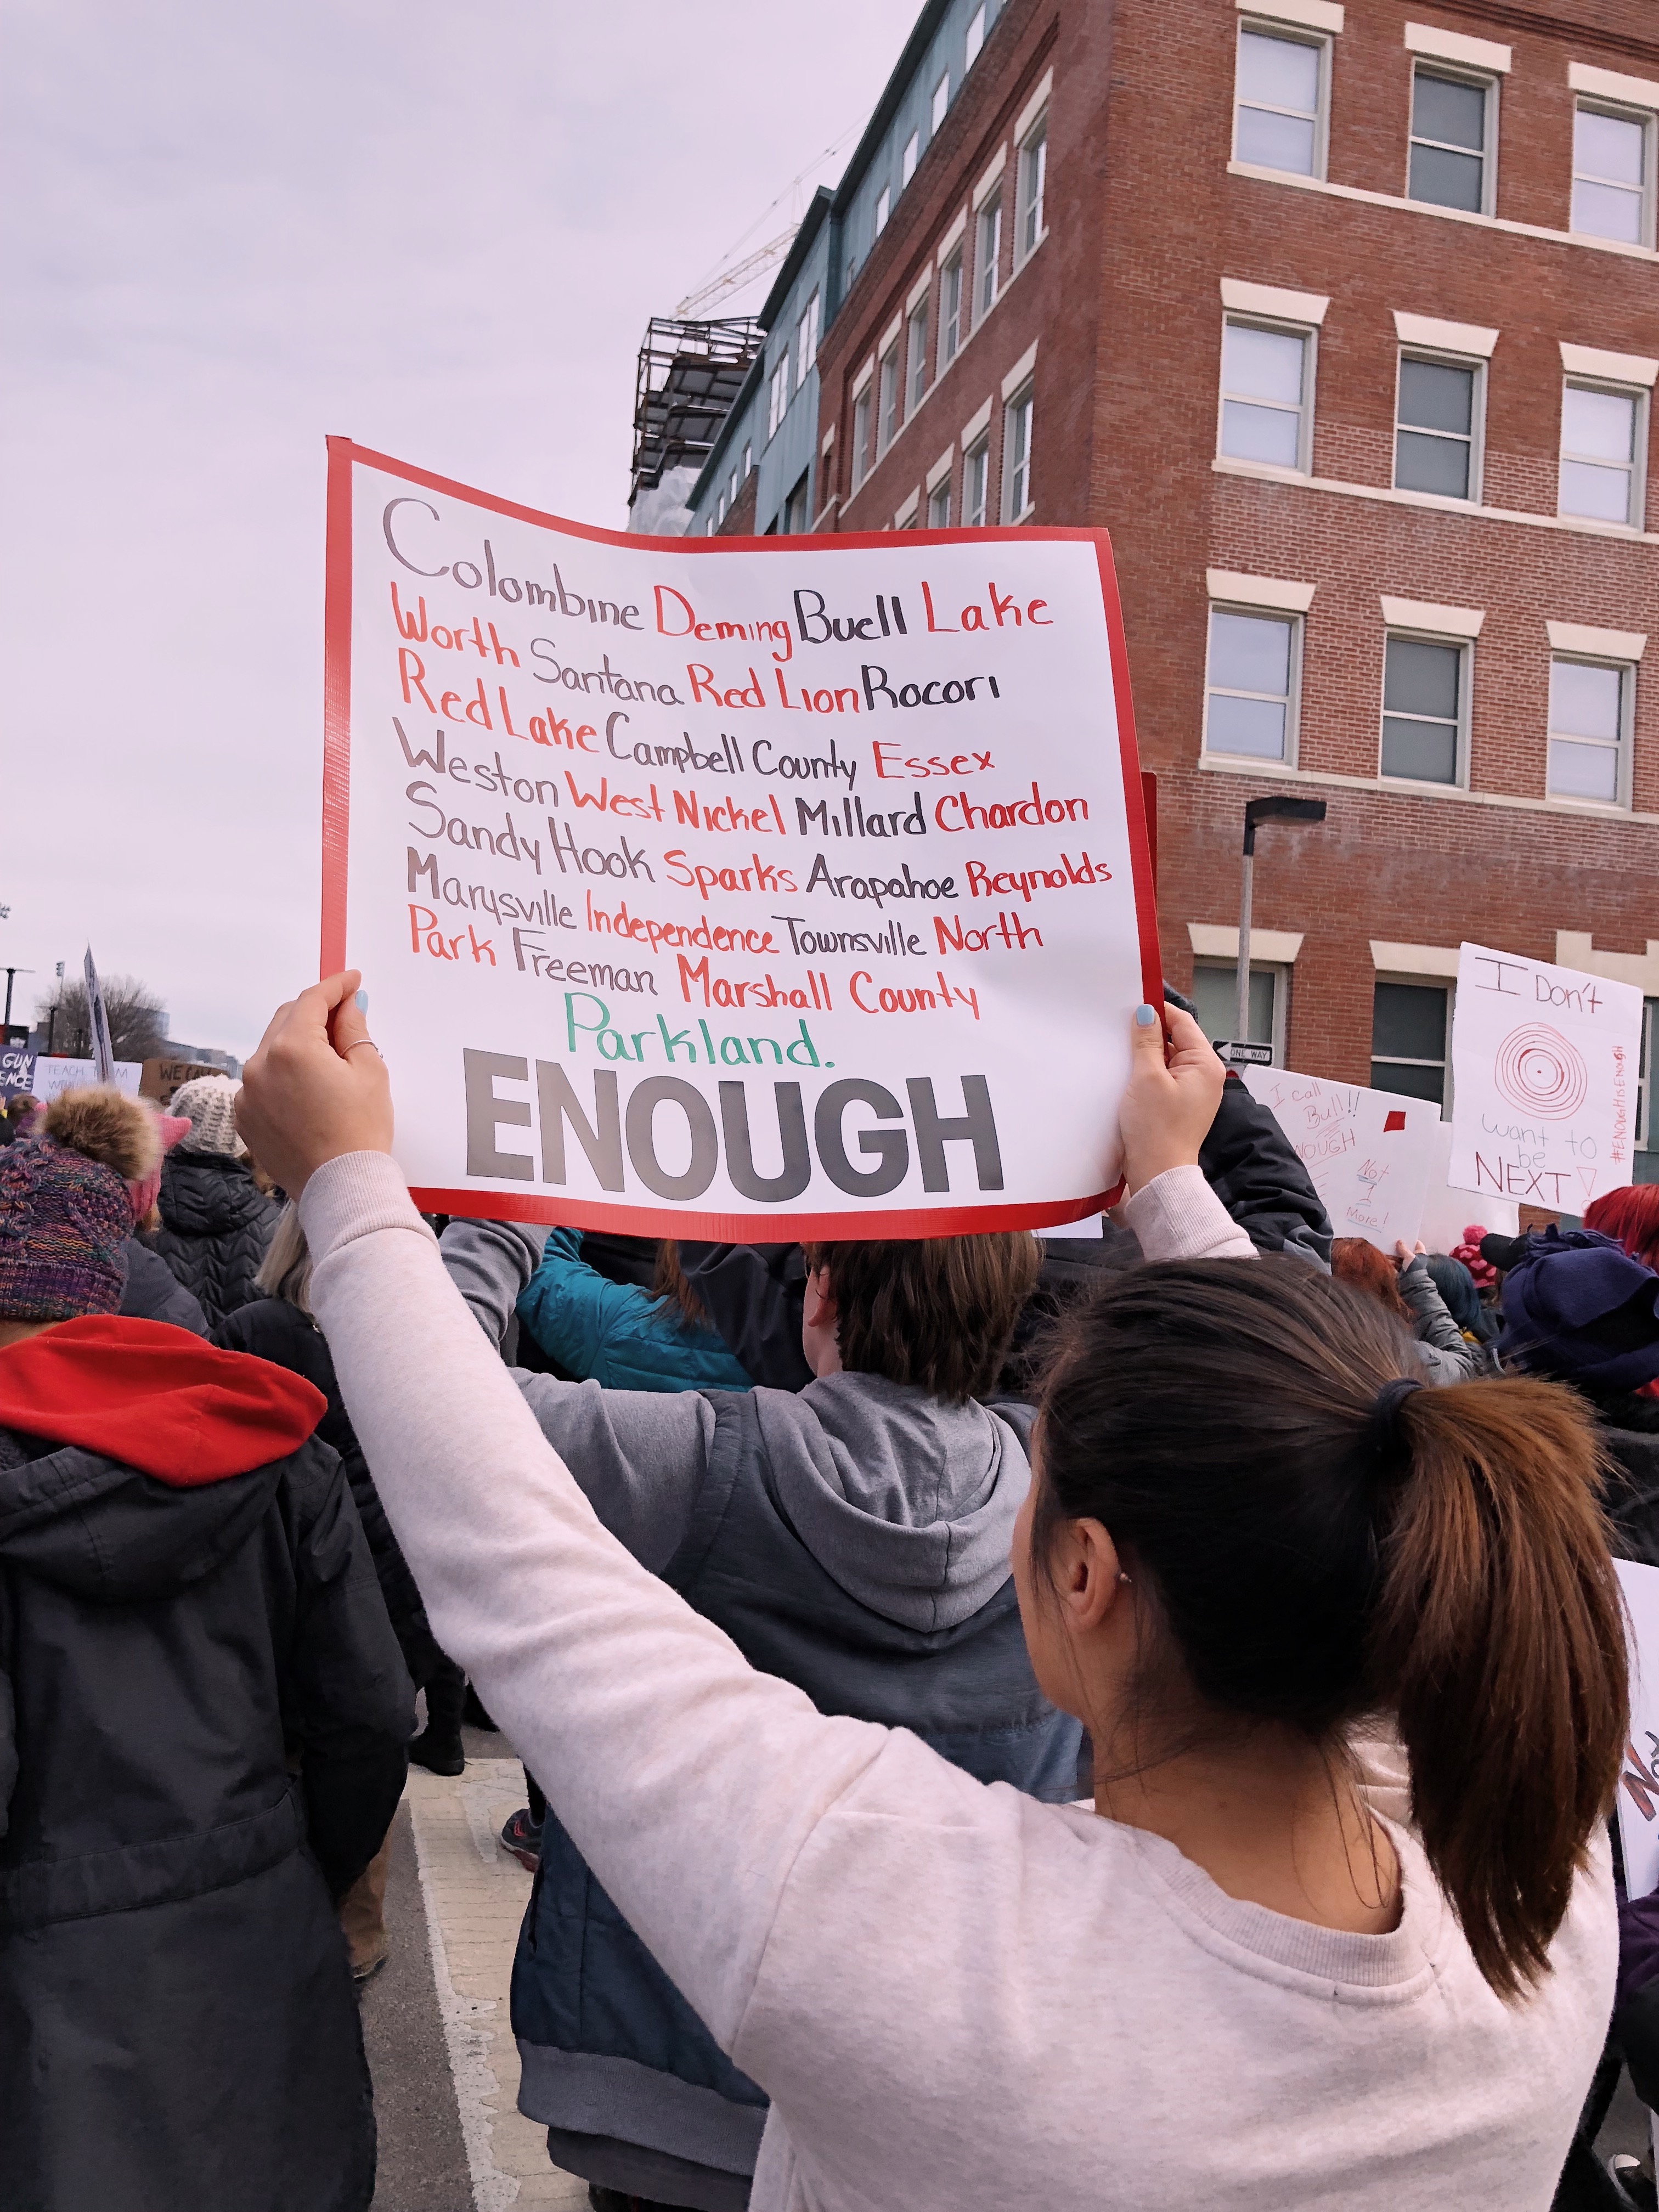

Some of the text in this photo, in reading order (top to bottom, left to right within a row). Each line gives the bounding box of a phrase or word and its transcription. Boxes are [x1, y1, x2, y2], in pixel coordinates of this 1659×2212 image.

[384, 498, 1054, 662] Colombine Deming Buell Lake
[391, 581, 1001, 714] Worth Santana Red Lion Rocori
[398, 648, 997, 791] Red Lake Campbell County Essex
[392, 716, 1089, 838] Weston West Nickel Millard Chardon
[405, 781, 1113, 909] Sandy Hook Sparks Arapahoe Reynolds
[407, 846, 1044, 957] Marysville Independence Townsville North
[407, 904, 981, 1020] Park Freeman Marshall County
[1475, 957, 1603, 1014] I Don't
[565, 992, 836, 1068] Parkland.
[1231, 1049, 1267, 1059] ONE WAY
[0, 1071, 33, 1091] ENCE
[2, 1052, 33, 1069] GUN
[46, 1064, 84, 1076] TEACH
[160, 1062, 183, 1081] WE
[1270, 1082, 1285, 1109] I
[463, 1047, 1005, 1203] ENOUGH
[1294, 1128, 1356, 1160] NOUGH
[1565, 1130, 1597, 1159] to
[1518, 1144, 1546, 1169] be
